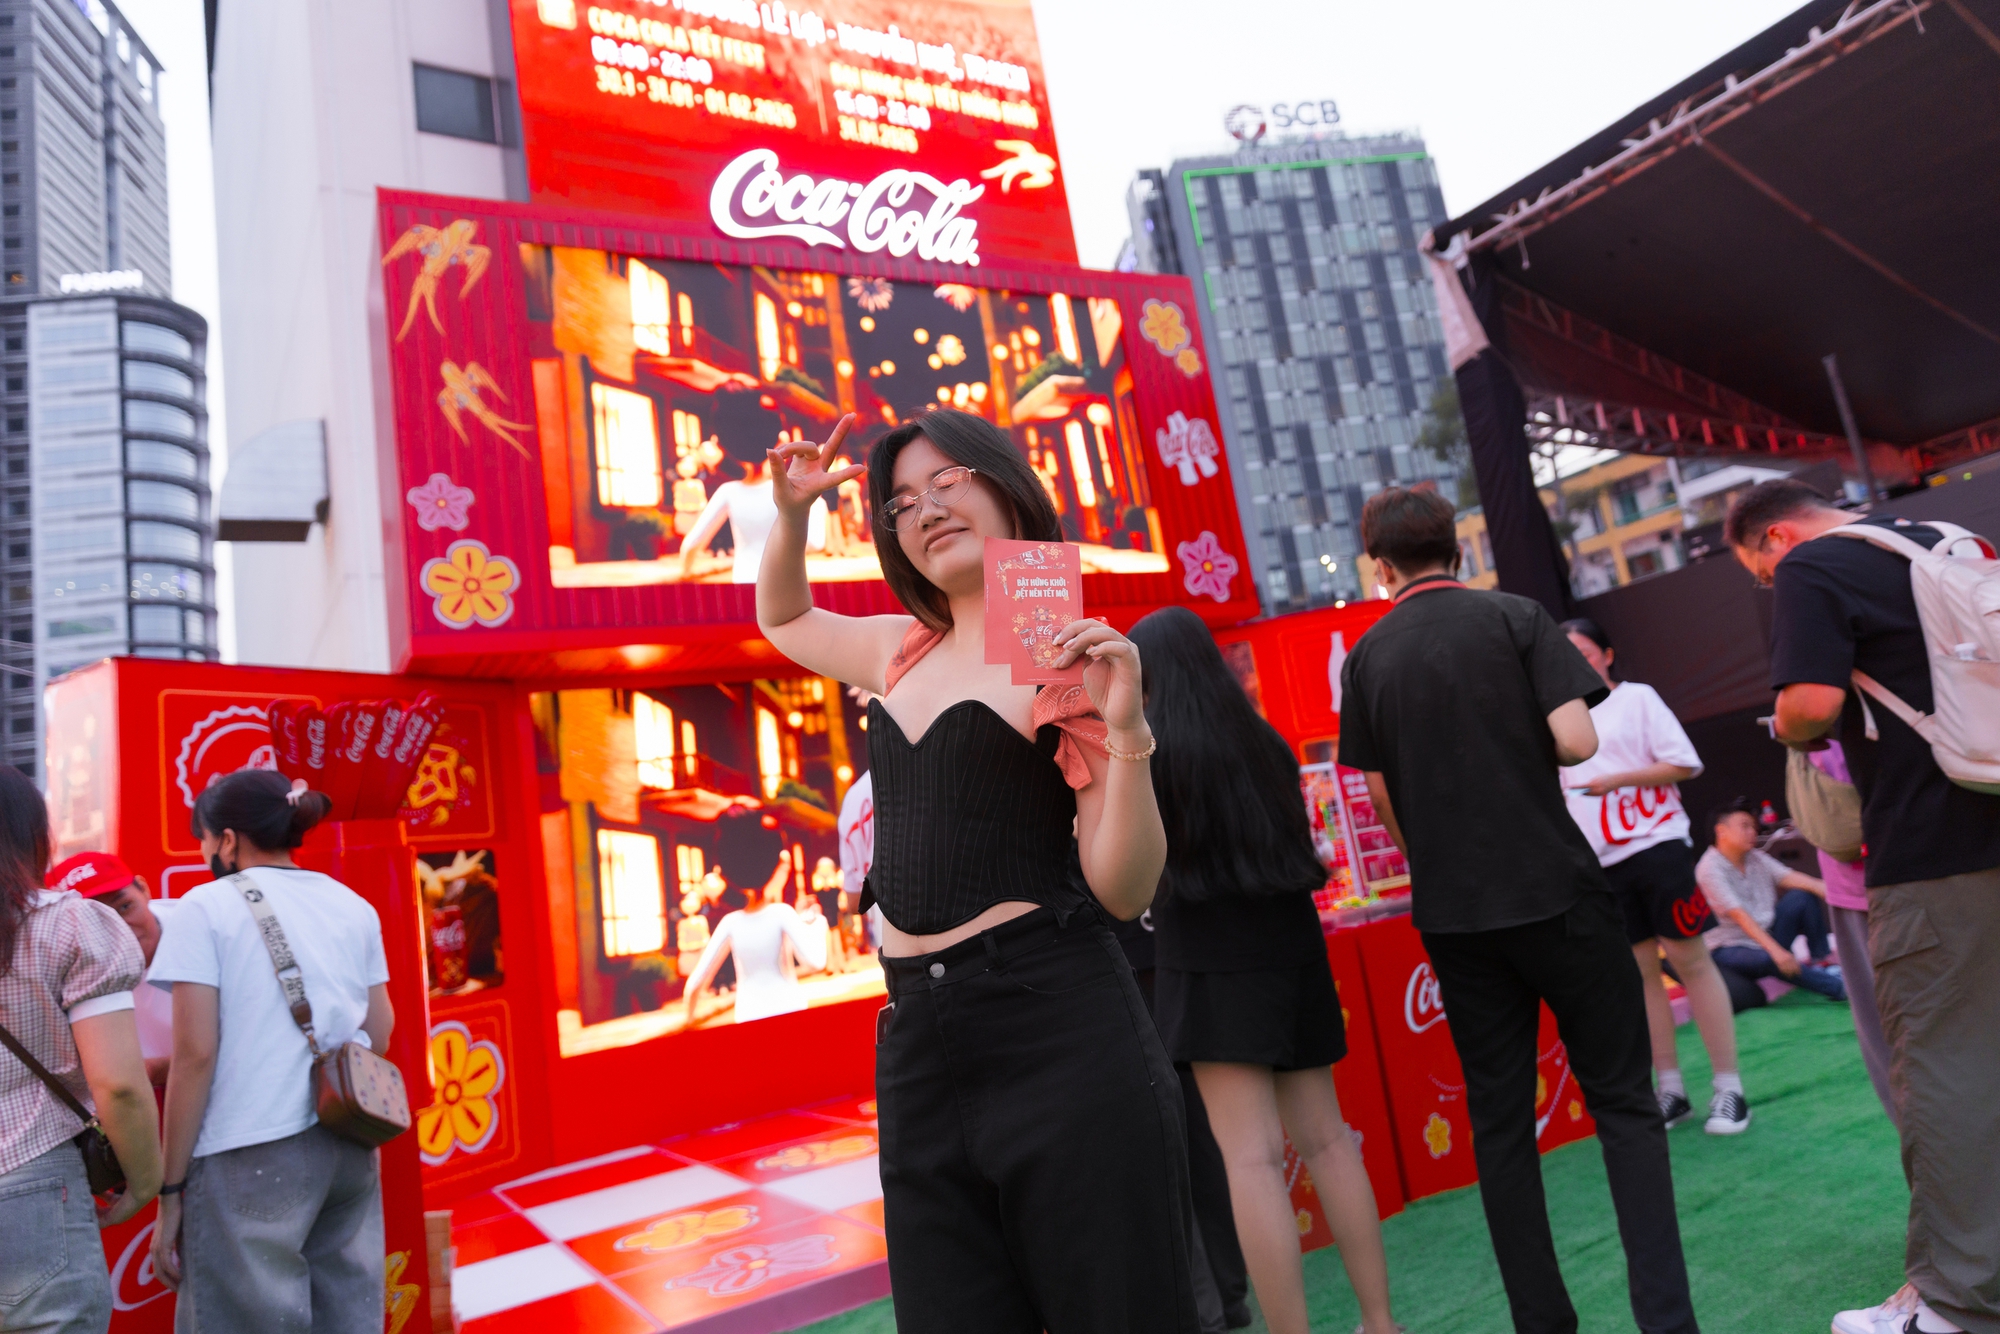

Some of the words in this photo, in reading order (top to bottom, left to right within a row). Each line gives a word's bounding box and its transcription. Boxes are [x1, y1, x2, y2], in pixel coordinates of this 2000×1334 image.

[588, 6, 640, 42] COCA
[640, 18, 690, 52] COLA
[1271, 99, 1340, 128] SCB
[709, 148, 985, 267] Coca-Cola
